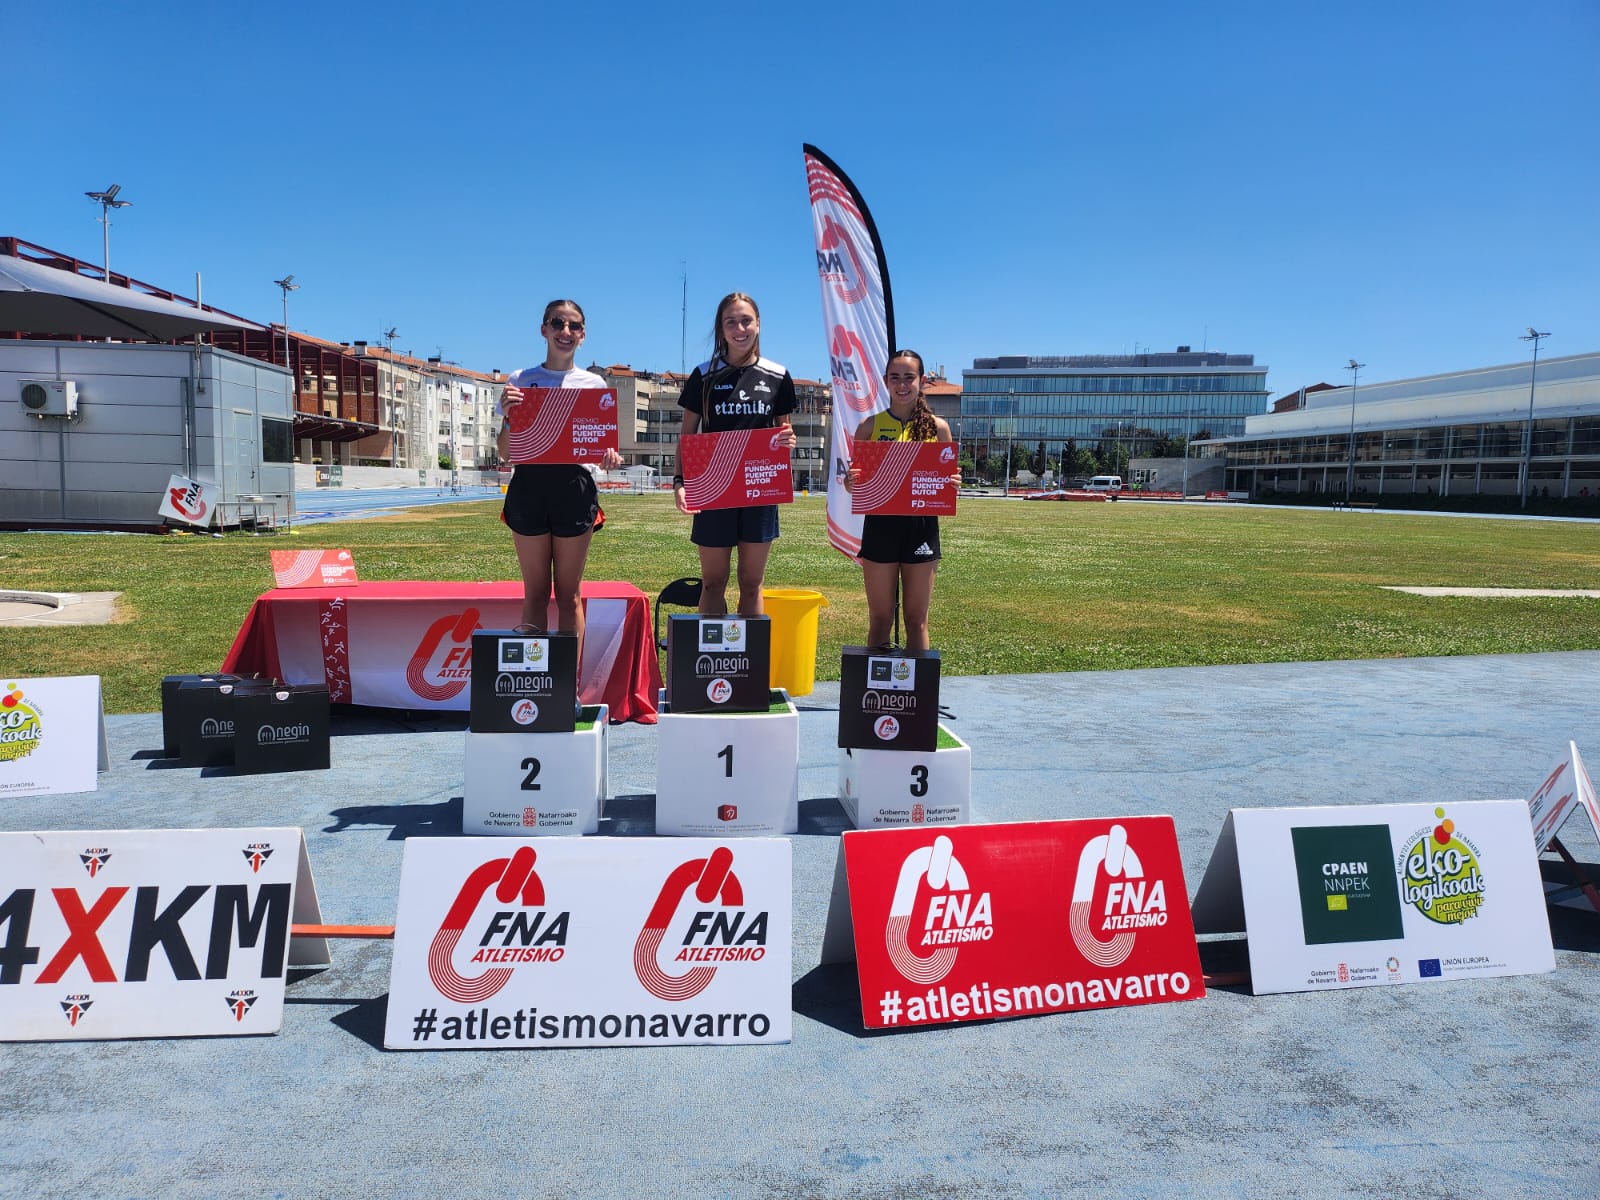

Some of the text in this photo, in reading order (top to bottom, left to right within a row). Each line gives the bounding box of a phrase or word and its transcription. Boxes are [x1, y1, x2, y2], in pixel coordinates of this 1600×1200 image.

[745, 463, 788, 472] FUNDACIÓN
[186, 482, 200, 507] FNA
[521, 757, 540, 790] 2
[718, 745, 733, 777] 1
[910, 765, 928, 797] 3
[1322, 862, 1368, 876] CPAEN
[1105, 880, 1167, 915] FNA
[1325, 877, 1370, 891] NNPEK
[925, 893, 992, 930] FNA
[1102, 912, 1167, 930] ATLETISMO
[1436, 900, 1463, 917] para
[479, 911, 570, 946] FNA
[682, 911, 769, 946] FNA
[921, 926, 994, 945] ATLETISMO
[470, 948, 565, 963] ATLETISMO
[675, 947, 766, 962] ATLETISMO
[880, 971, 1190, 1024] #atletismonavarro
[412, 1008, 770, 1040] #atletismonavarro
